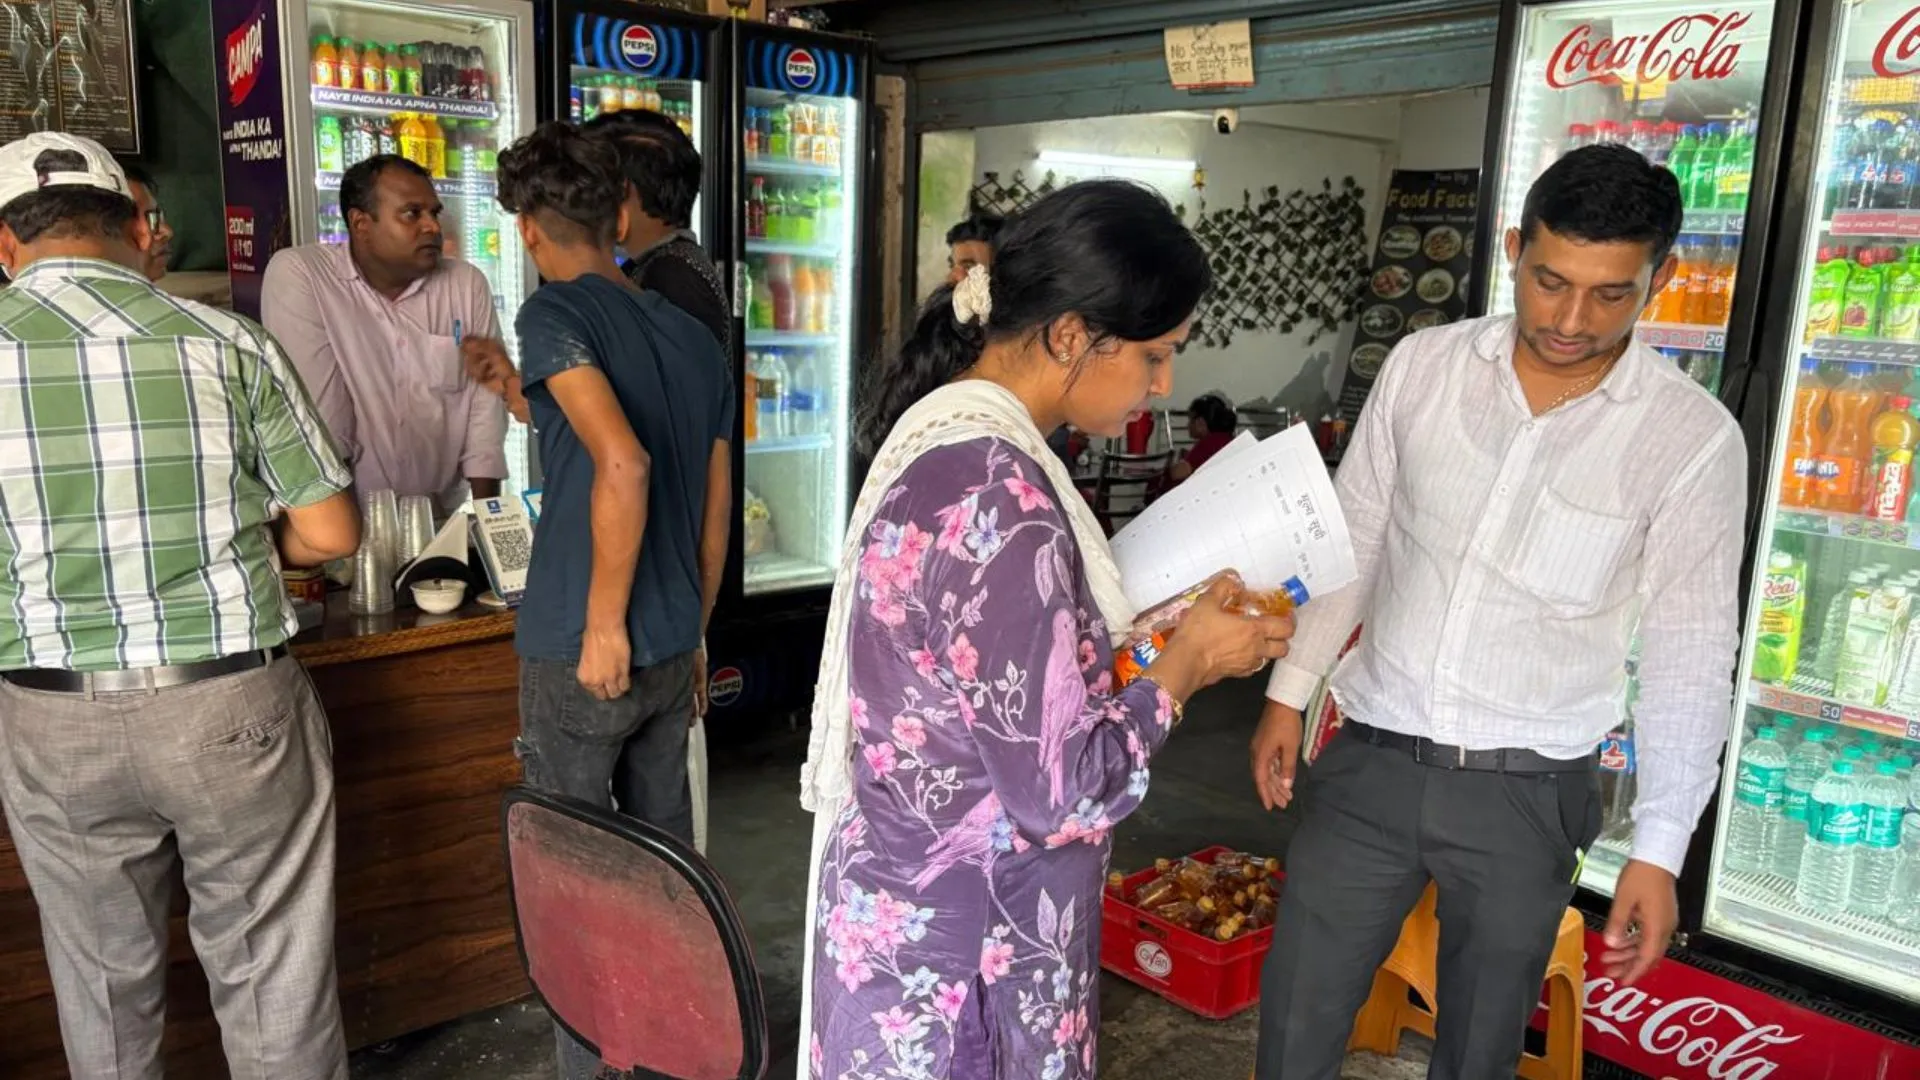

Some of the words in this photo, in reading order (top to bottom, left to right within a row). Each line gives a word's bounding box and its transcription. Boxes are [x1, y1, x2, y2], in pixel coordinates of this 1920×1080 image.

[229, 18, 263, 86] CAMPA
[624, 39, 656, 53] PEPSI
[1546, 11, 1753, 89] Coca-Cola
[787, 63, 815, 74] PEPSI
[351, 94, 384, 105] INDIA
[384, 97, 402, 107] KA
[406, 99, 437, 110] APNA
[234, 119, 256, 139] INDIA
[257, 117, 272, 136] KA
[1386, 188, 1430, 209] Food
[1706, 333, 1724, 346] 20
[1821, 704, 1841, 720] 50
